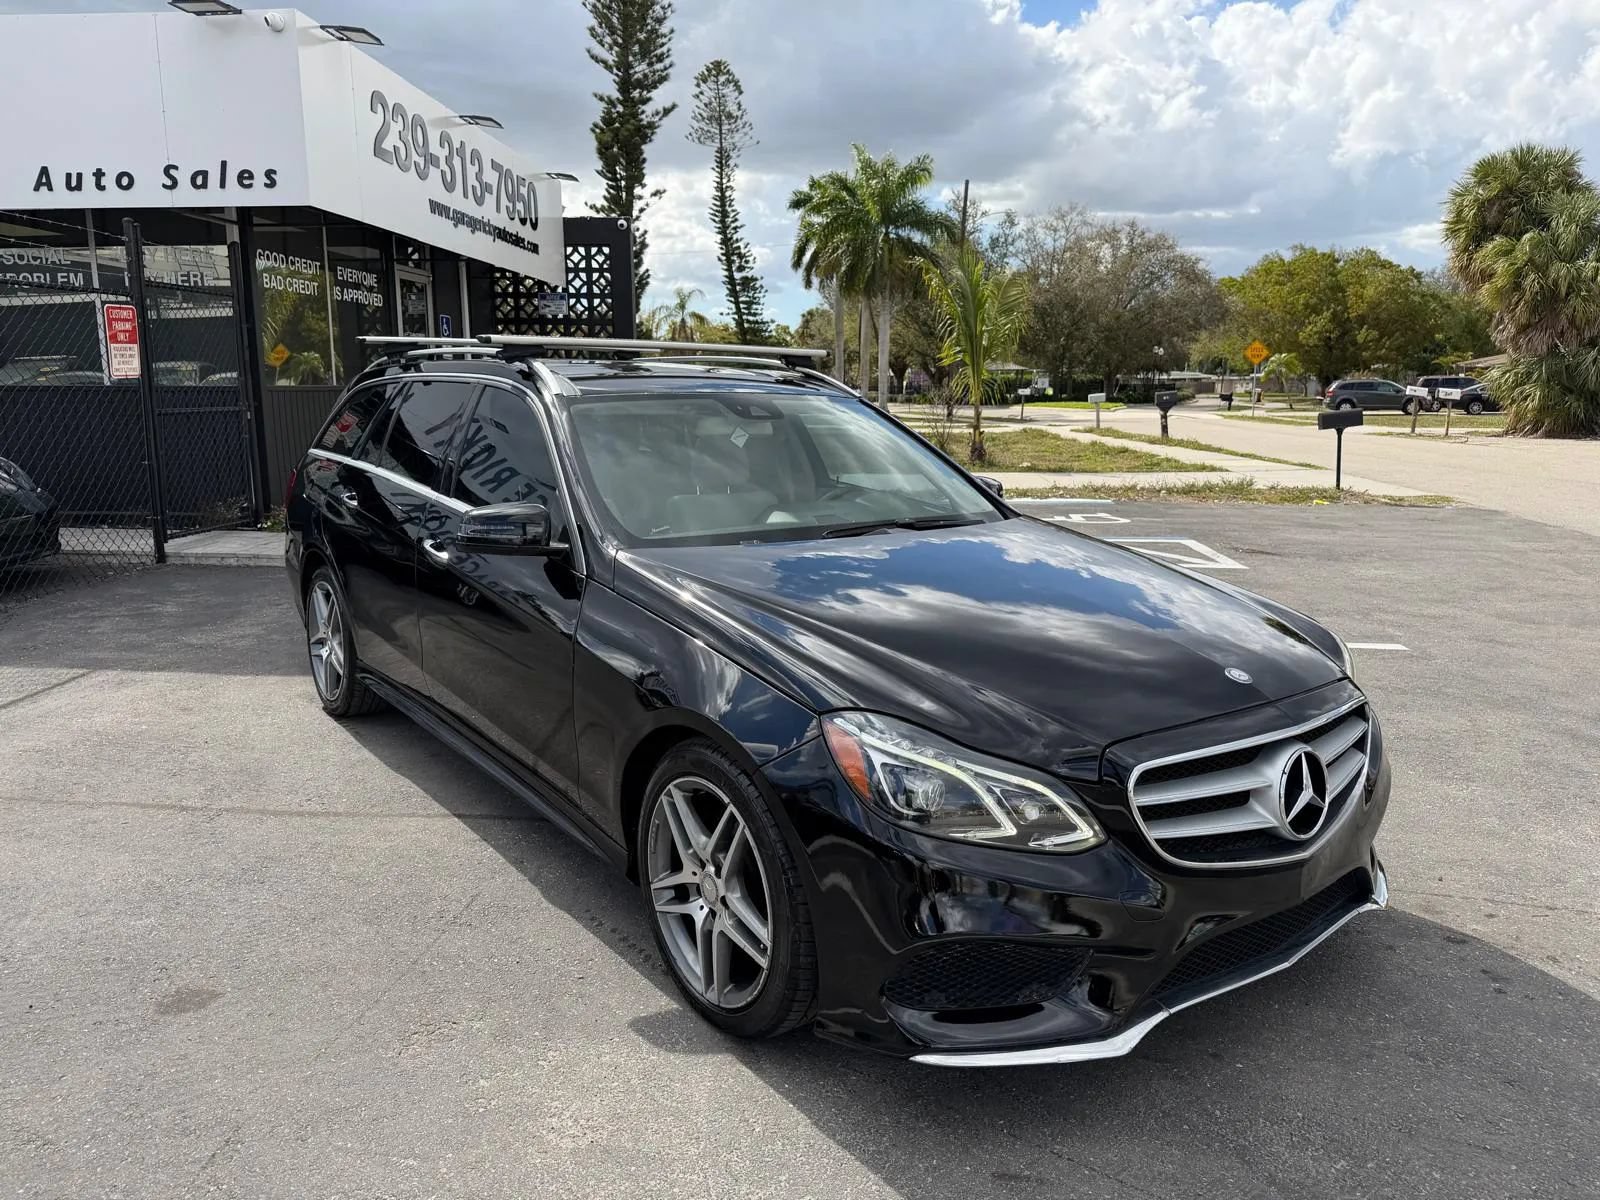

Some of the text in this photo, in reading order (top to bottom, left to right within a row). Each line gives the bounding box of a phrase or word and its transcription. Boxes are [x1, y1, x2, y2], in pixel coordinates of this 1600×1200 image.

[370, 90, 539, 231] 239-313-7950
[33, 160, 278, 192] Auto Sales
[428, 198, 540, 255] www.garagerickyautosales.com
[2, 247, 71, 265] SOCIAL
[256, 249, 321, 276] GOOD CREDIT
[262, 273, 319, 297] BAD CREDIT
[336, 266, 378, 288] EVERYONE
[333, 286, 384, 307] IS APPROVED
[109, 309, 133, 319] CUSTOMER
[111, 320, 133, 331] PARKING
[116, 332, 129, 342] ONLY
